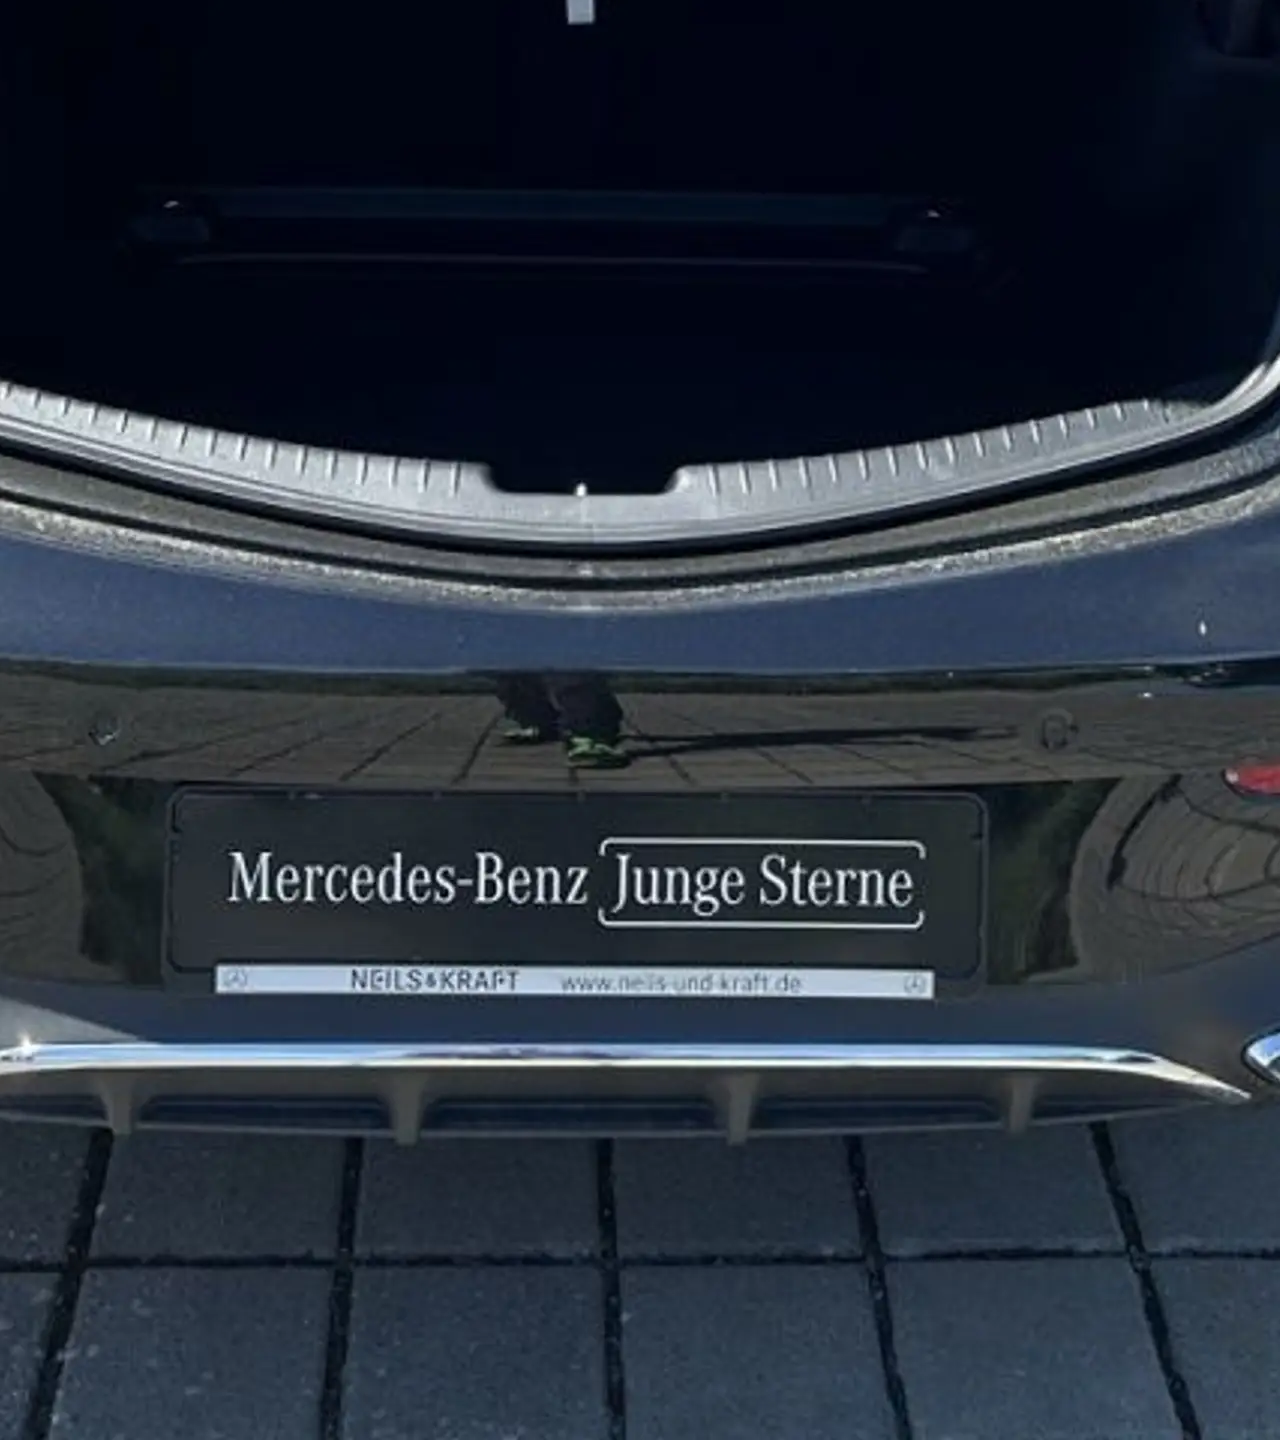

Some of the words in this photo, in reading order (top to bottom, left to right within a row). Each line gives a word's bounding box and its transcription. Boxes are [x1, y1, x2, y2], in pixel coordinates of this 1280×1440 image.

[227, 851, 589, 905] Mercedes-Benz
[612, 852, 746, 916] Junge
[759, 853, 914, 907] Sterne
[561, 971, 803, 995] www.neils-und-kraft.de
